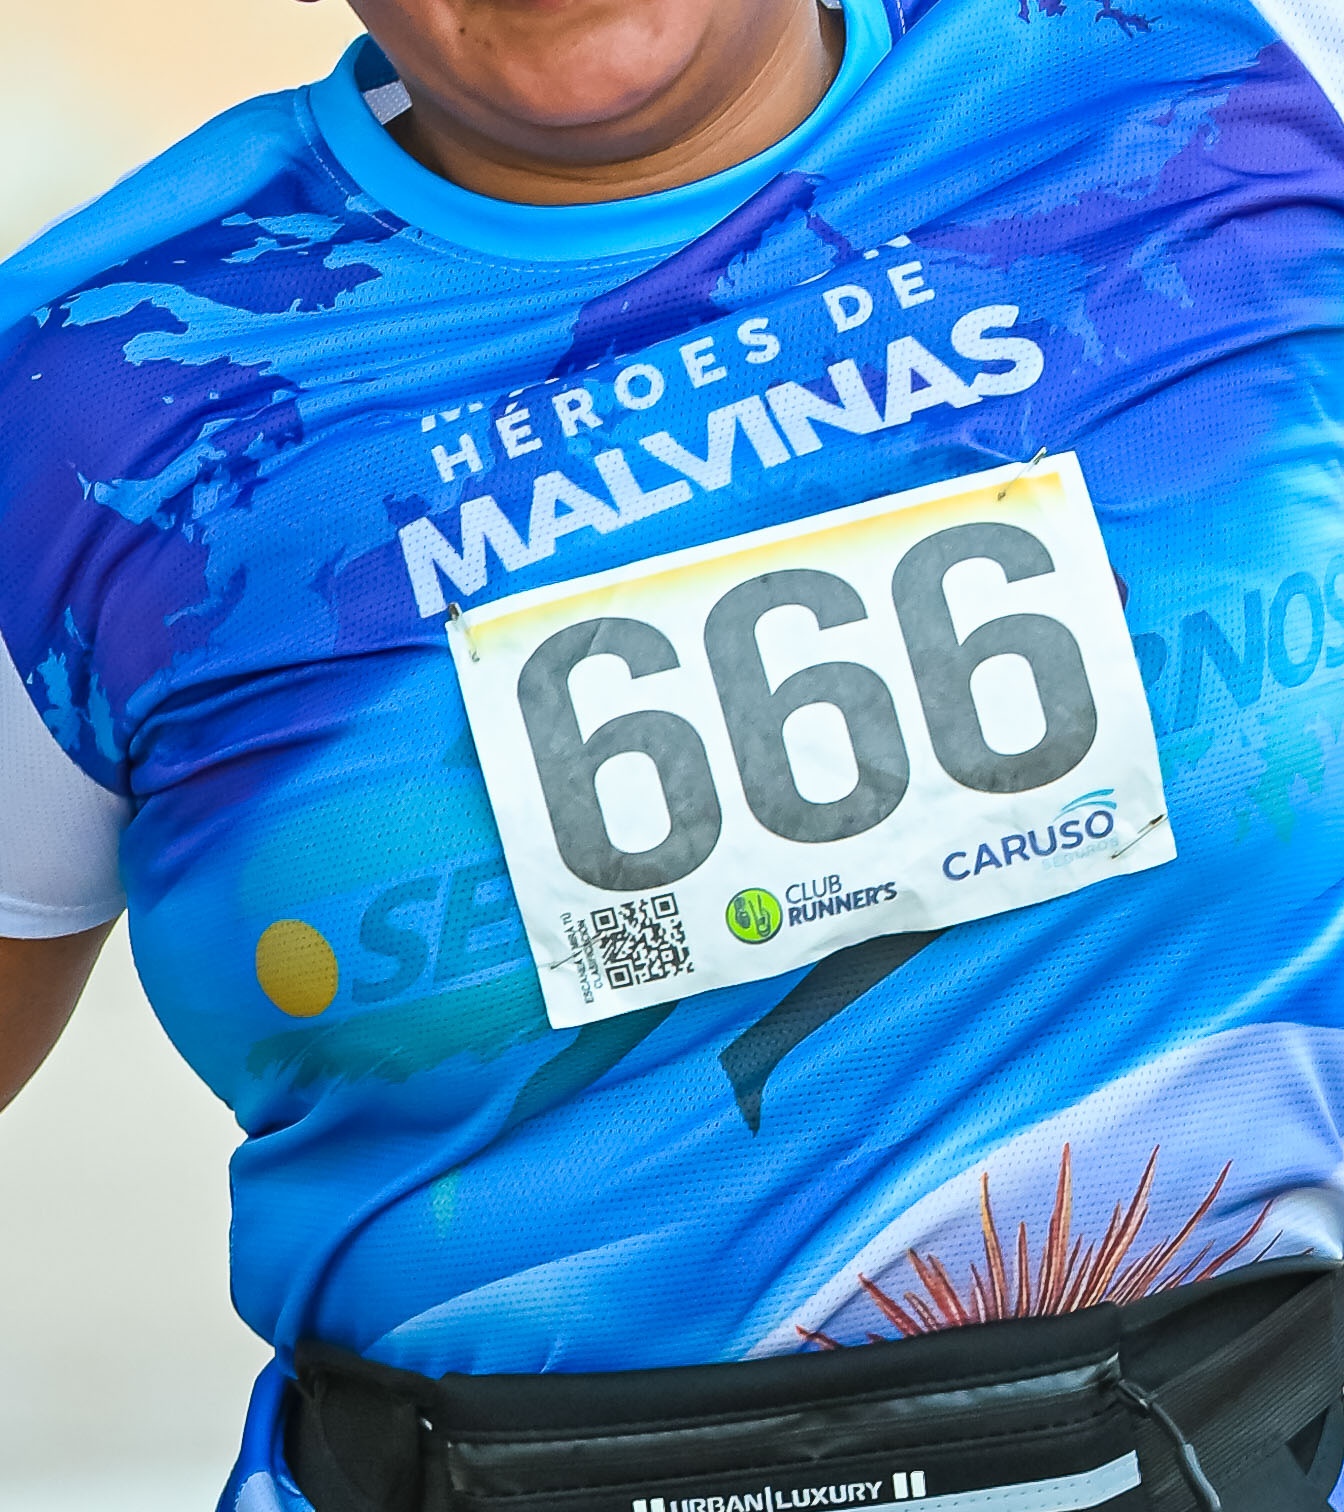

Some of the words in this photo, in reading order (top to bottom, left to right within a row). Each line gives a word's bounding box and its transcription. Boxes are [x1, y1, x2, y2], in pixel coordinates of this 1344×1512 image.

[397, 303, 1046, 619] MALVINAS
[431, 318, 782, 485] HÉROES
[822, 259, 936, 333] DE
[516, 521, 1098, 892] 666
[785, 874, 843, 905] CLUB
[942, 810, 1115, 881] CARUSO
